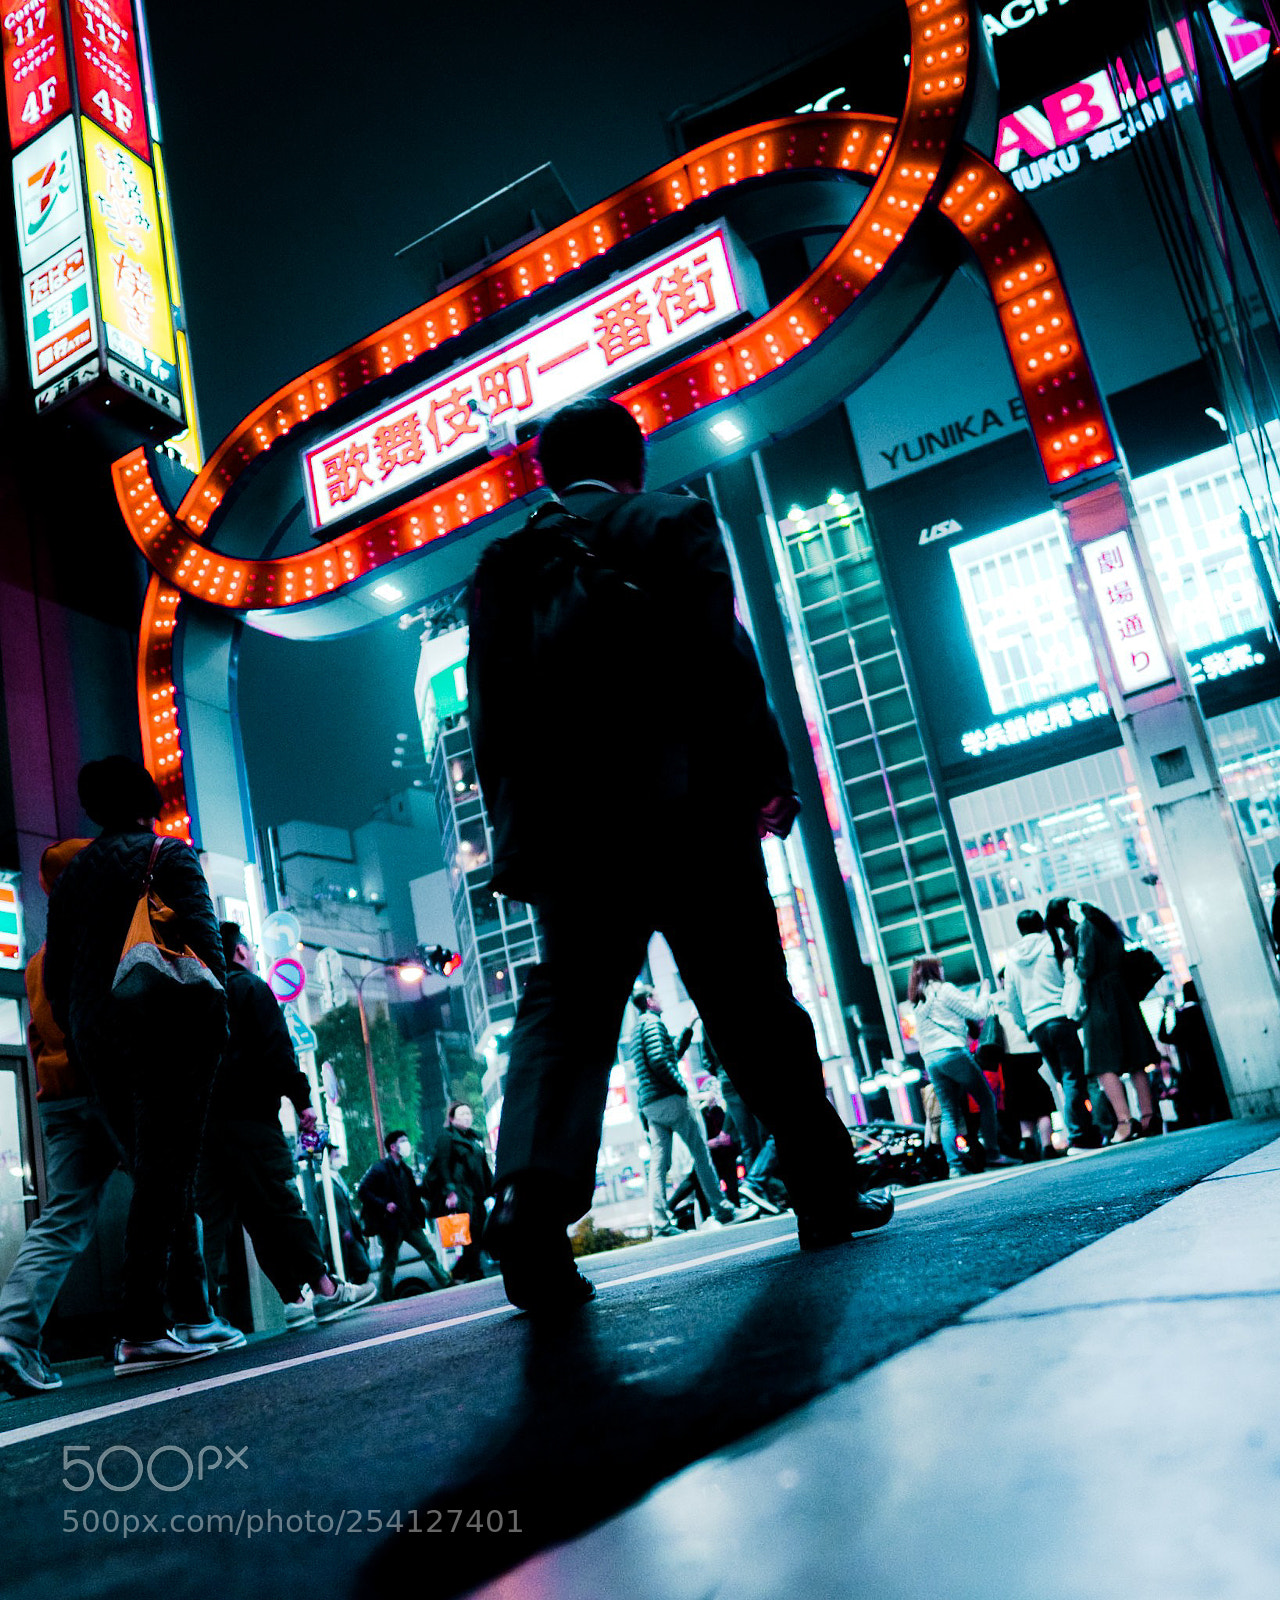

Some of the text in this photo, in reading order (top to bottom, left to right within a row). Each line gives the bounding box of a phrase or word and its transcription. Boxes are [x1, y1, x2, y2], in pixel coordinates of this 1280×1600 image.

[14, 6, 46, 47] 117
[83, 12, 120, 54] 117
[21, 75, 58, 125] 4F
[320, 252, 717, 508] 歌舞伎町一番街
[879, 407, 1005, 471] YUNIKA
[1096, 544, 1151, 674] 劇場通り
